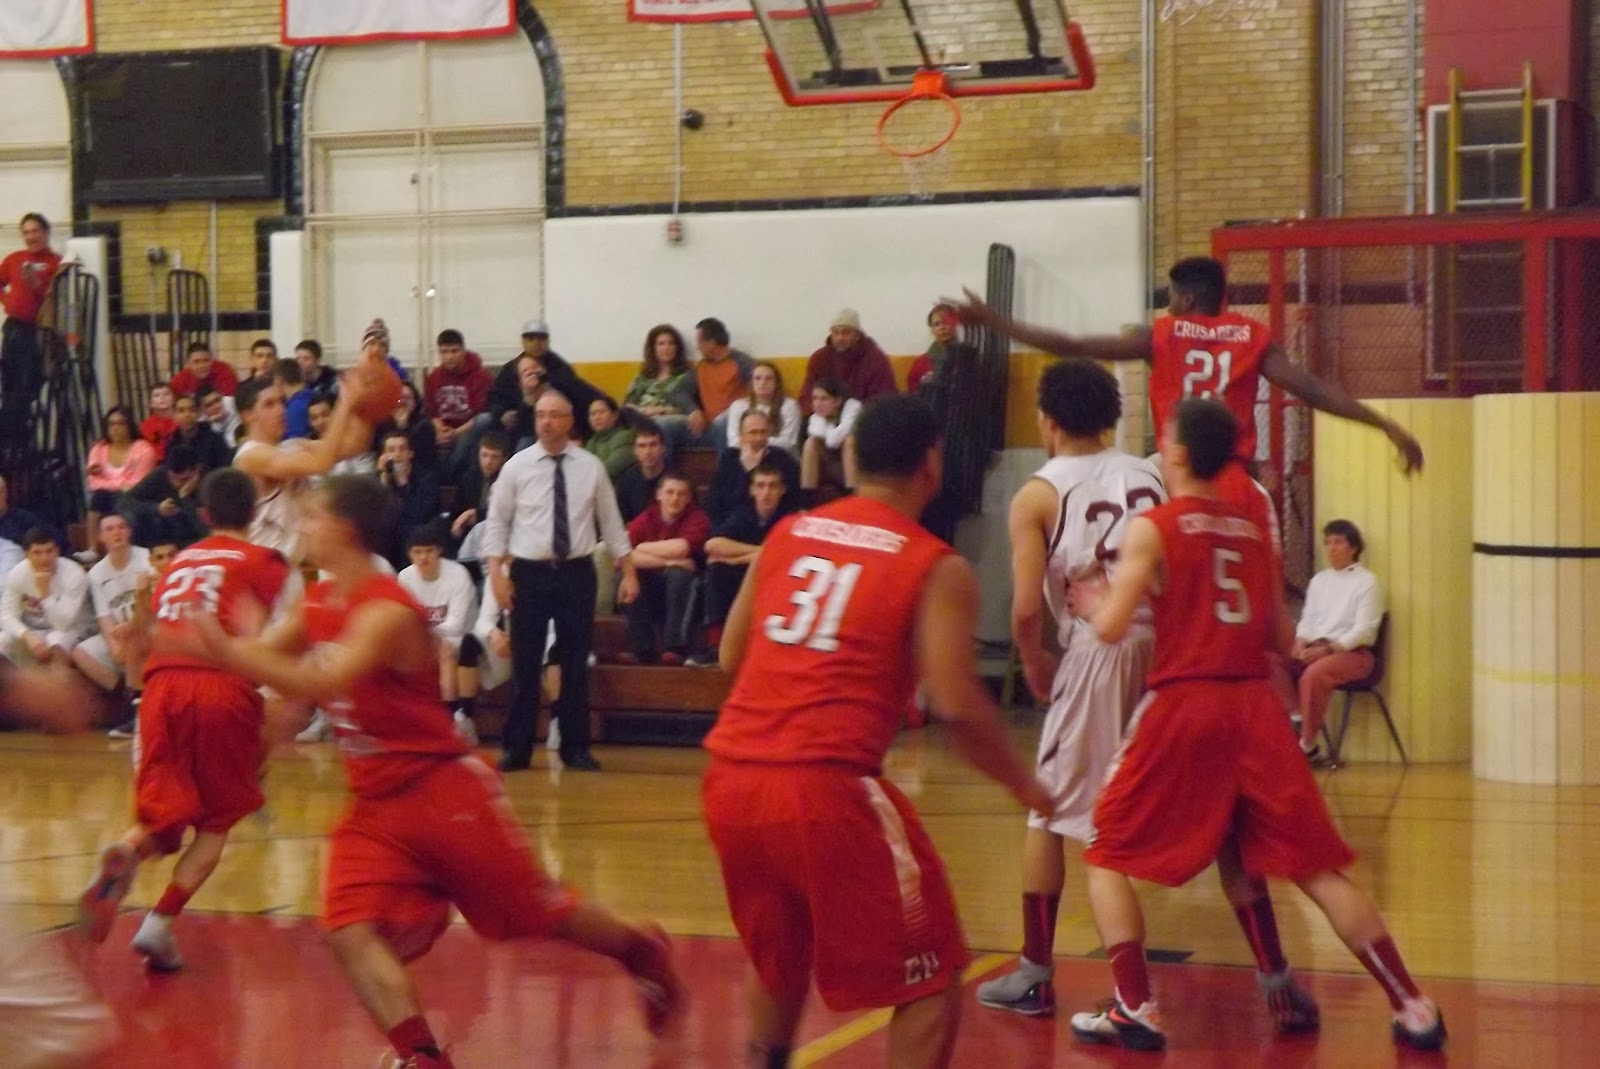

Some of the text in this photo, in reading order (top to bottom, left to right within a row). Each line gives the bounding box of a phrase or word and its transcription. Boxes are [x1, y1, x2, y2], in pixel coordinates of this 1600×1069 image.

[1174, 319, 1251, 343] CRUSADERS
[1183, 349, 1232, 400] 21
[157, 564, 226, 621] 23
[764, 554, 864, 652] 31
[1213, 547, 1251, 624] 5
